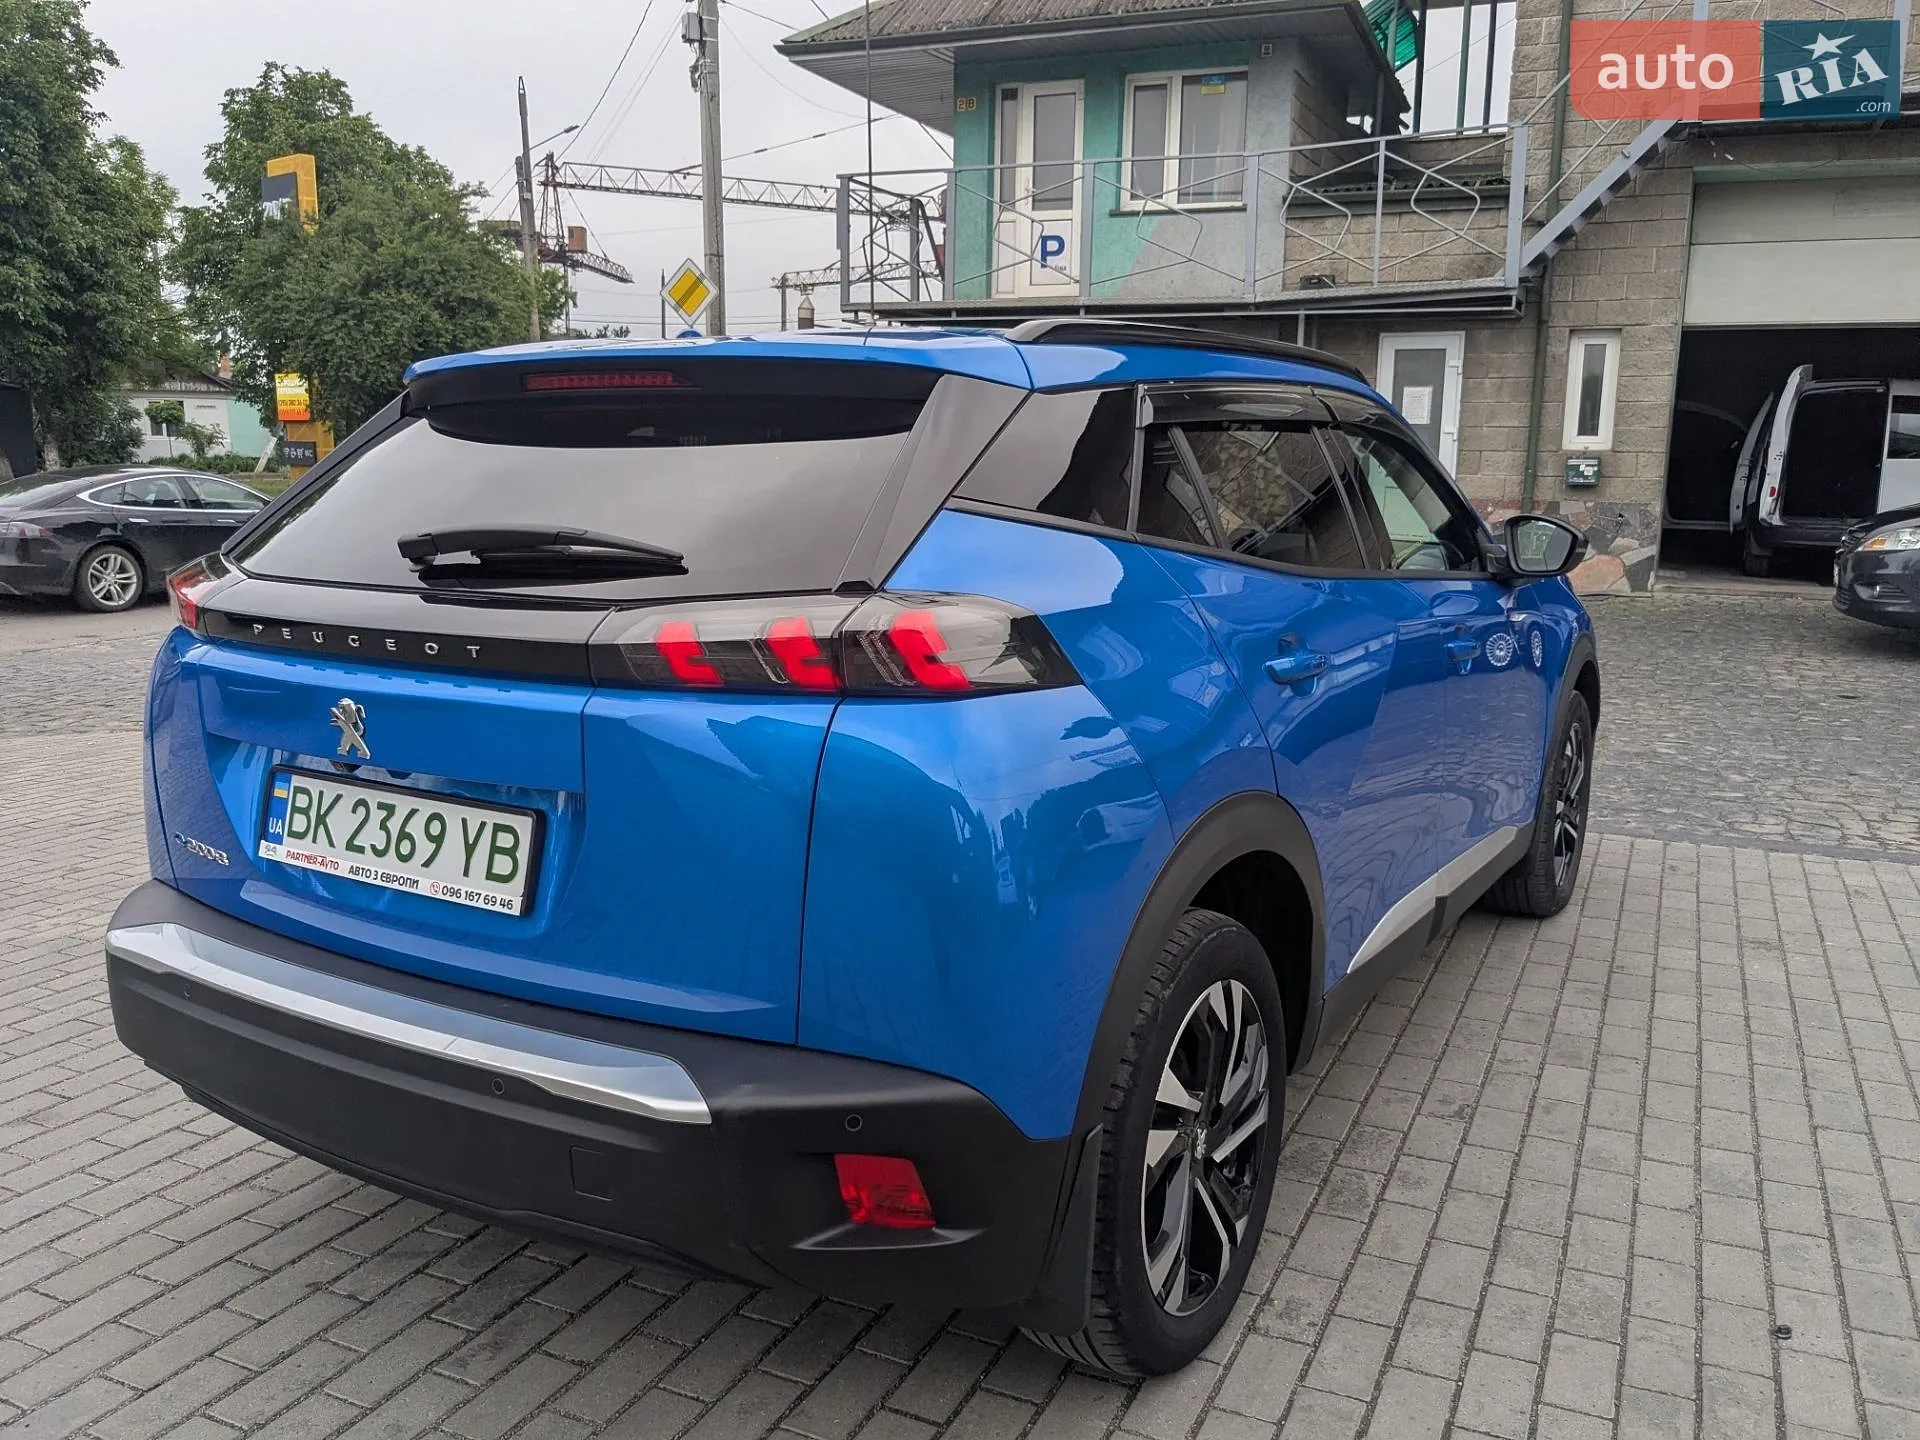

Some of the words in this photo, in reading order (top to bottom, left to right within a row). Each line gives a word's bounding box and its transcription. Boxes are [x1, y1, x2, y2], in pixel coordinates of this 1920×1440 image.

[1040, 235, 1065, 268] P
[252, 623, 481, 658] PEUGEOT
[268, 817, 283, 835] UA
[286, 785, 344, 849] BK
[345, 797, 448, 868] 2369
[461, 817, 521, 884] YB
[348, 865, 372, 879] АВТО
[380, 872, 420, 890] ЄВРОПИ
[441, 885, 462, 899] 096
[464, 889, 482, 903] 167
[483, 895, 497, 907] 69
[499, 897, 514, 911] 46
